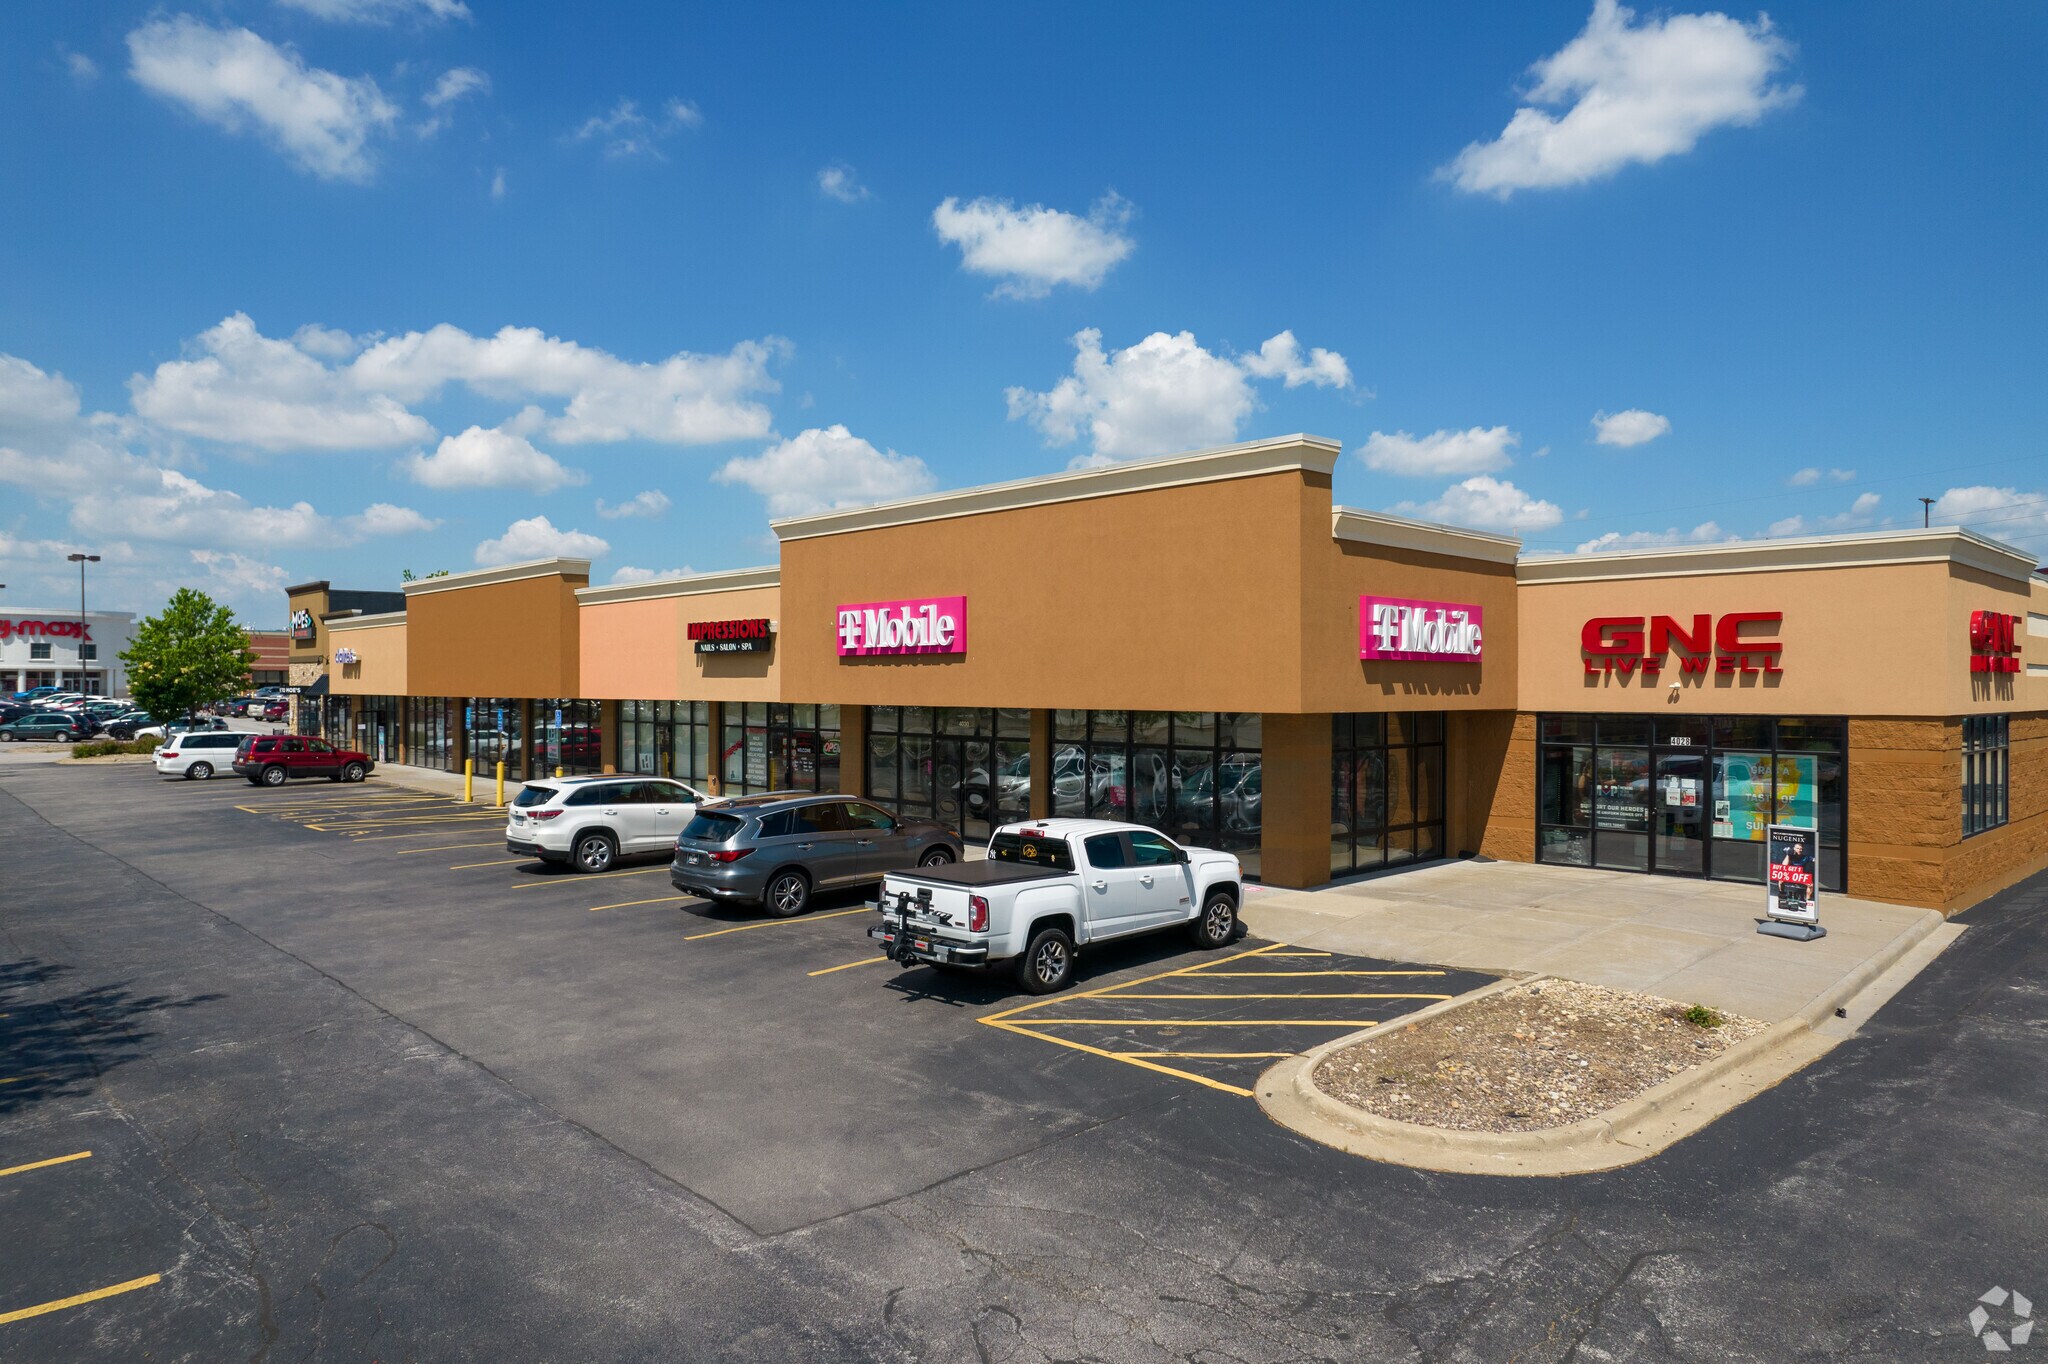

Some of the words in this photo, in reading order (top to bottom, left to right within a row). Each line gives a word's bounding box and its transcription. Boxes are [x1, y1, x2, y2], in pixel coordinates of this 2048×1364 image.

[687, 619, 767, 641] IMPRESSIONS
[1581, 611, 1784, 655] GNC
[700, 643, 715, 652] NAILS
[720, 642, 736, 651] SALON
[741, 642, 752, 651] SPA
[1584, 657, 1661, 675] LIVE
[1680, 655, 1784, 674] WELL
[1670, 737, 1691, 746] 4028
[1783, 767, 1790, 776] A
[1745, 793, 1772, 803] TAST
[1781, 795, 1796, 804] OF
[1772, 835, 1805, 843] NUGENIX
[1772, 870, 1790, 881] 50%
[1792, 873, 1809, 883] OFF
